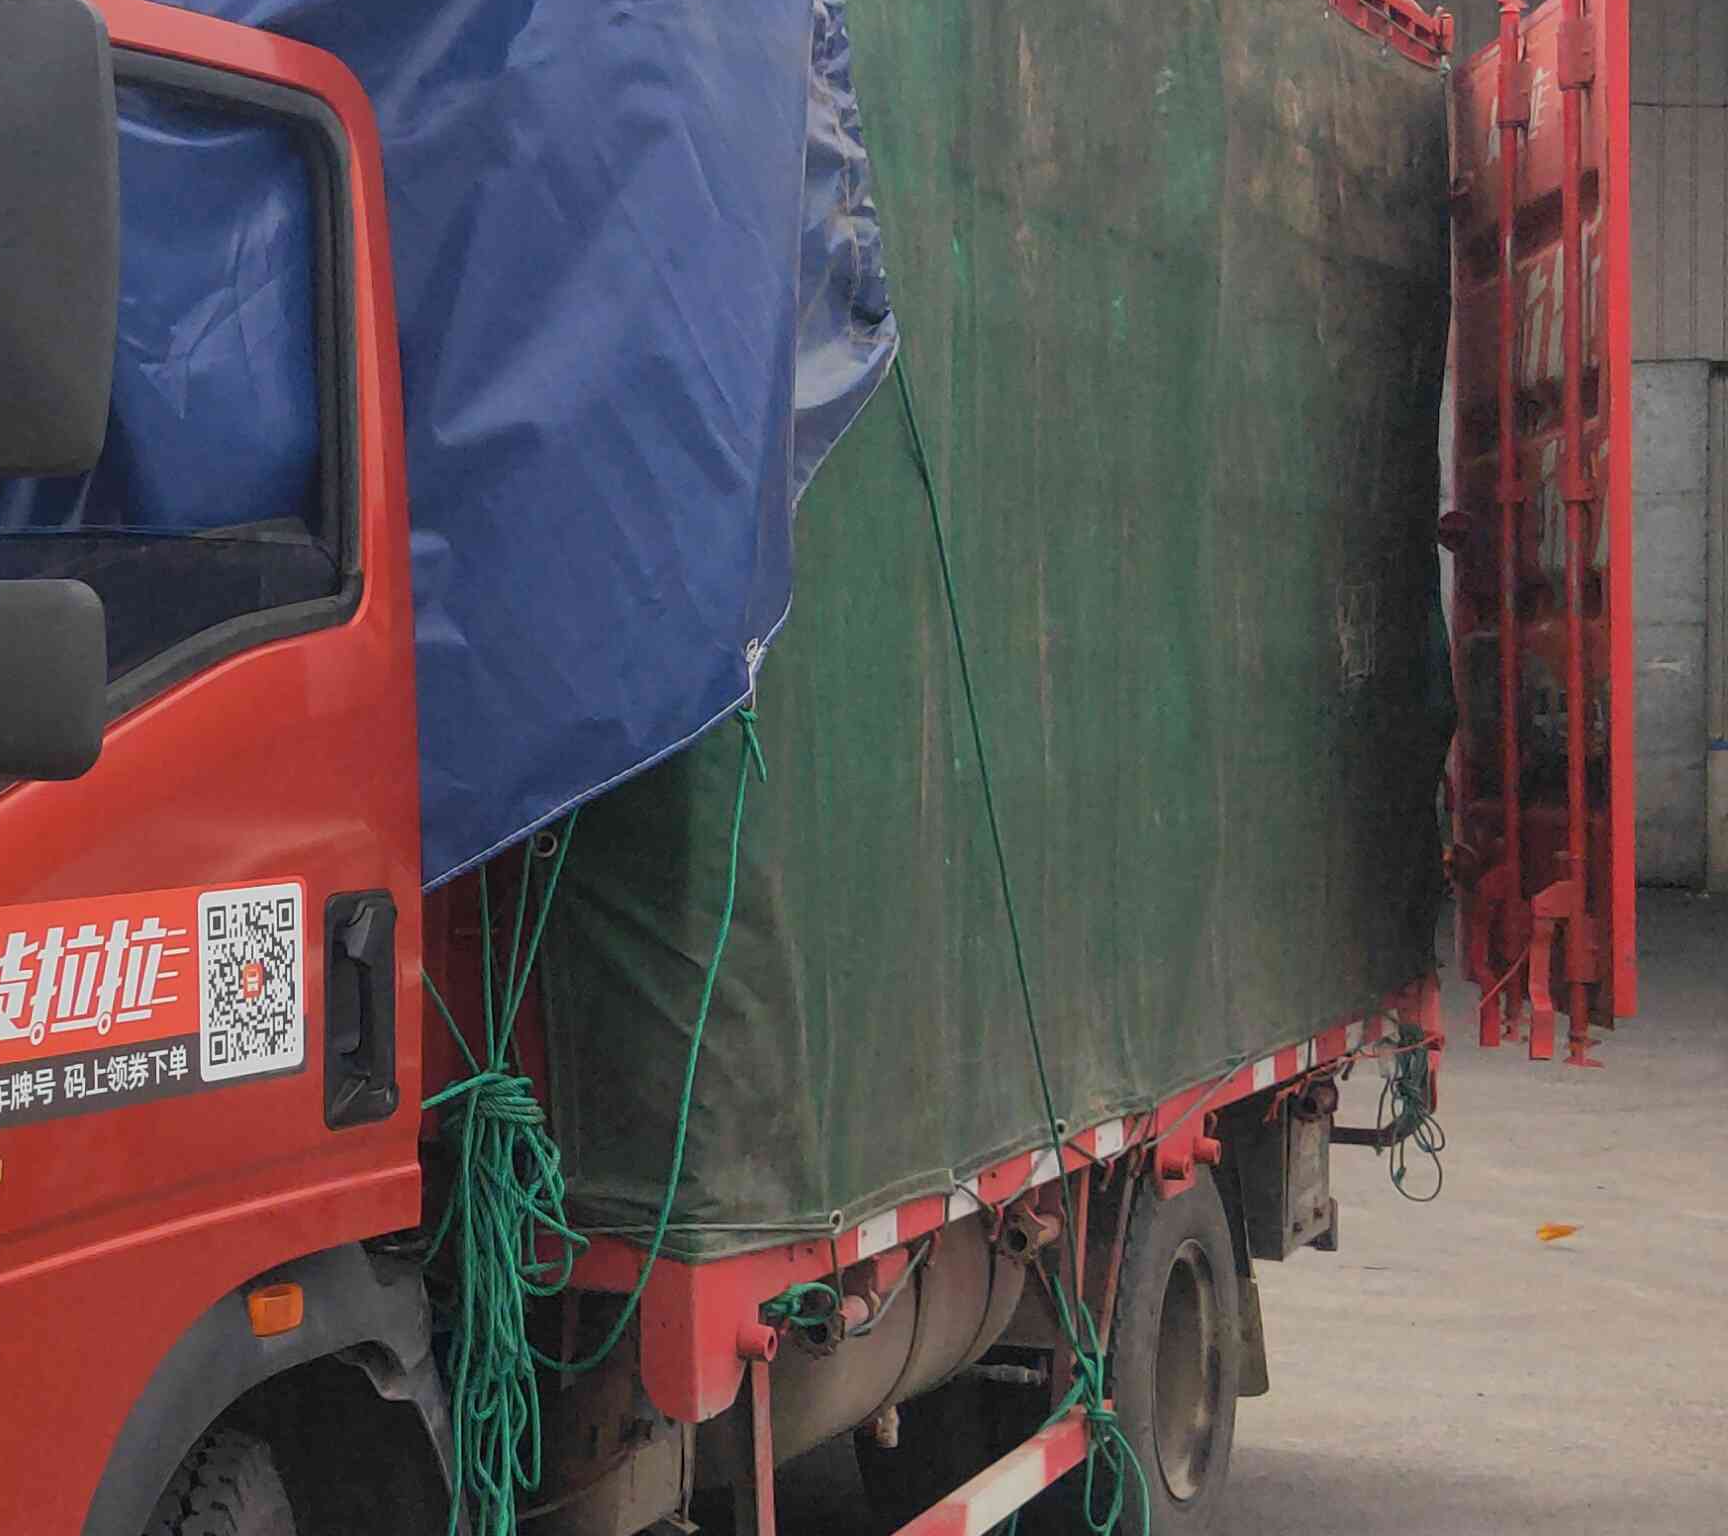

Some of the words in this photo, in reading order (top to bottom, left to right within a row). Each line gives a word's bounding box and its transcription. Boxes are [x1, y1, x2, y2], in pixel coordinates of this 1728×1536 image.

[63, 1044, 190, 1100] 码上领券下单
